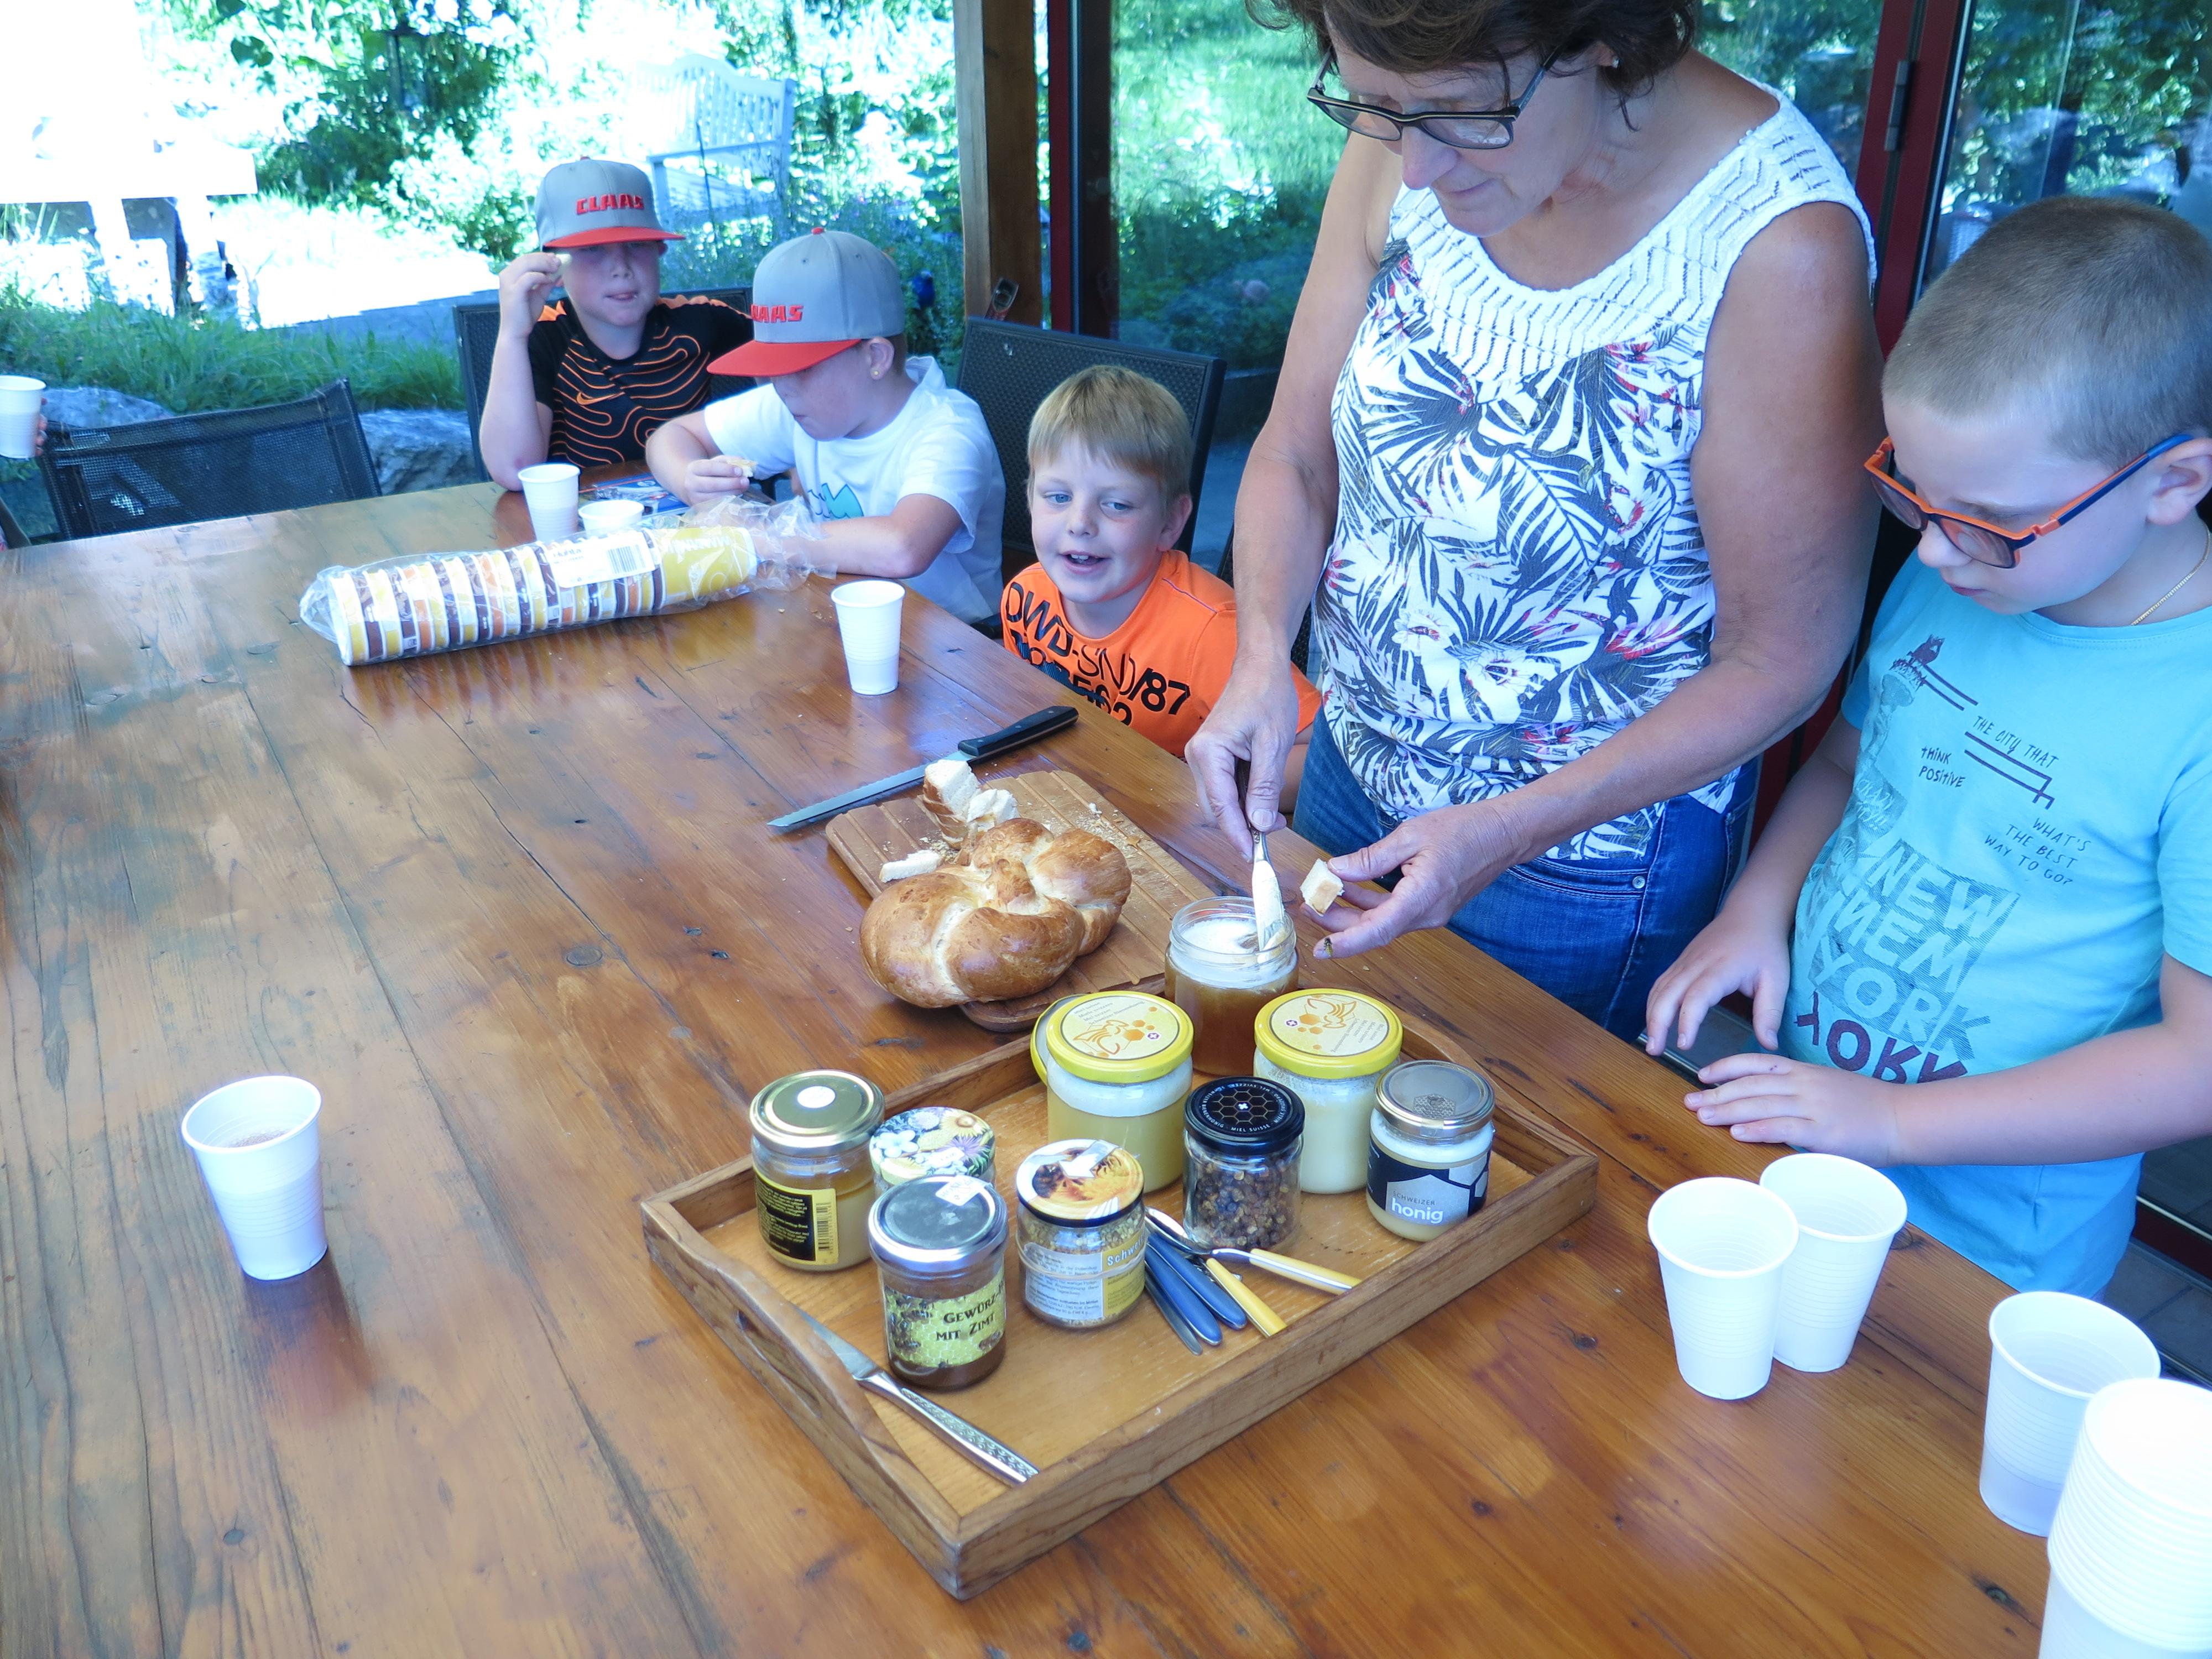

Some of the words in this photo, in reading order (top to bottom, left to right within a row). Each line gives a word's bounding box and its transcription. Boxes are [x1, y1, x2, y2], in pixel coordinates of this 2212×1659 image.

[576, 194, 644, 215] CLAAS
[1973, 716, 1995, 735] THE
[2023, 744, 2059, 769] THAT
[2006, 824, 2034, 847] THE
[2036, 845, 2078, 868] BEST
[2032, 817, 2091, 852] WHAT'S
[1984, 834, 2012, 857] WAY
[2018, 854, 2039, 871] TO
[1865, 846, 2019, 938] NEW
[1814, 936, 1991, 1061] YORK
[1249, 1123, 1271, 1132] SUISSE
[1391, 1197, 1444, 1224] honig
[1392, 1191, 1436, 1206] SCHWEIZER
[936, 1329, 961, 1341] MIT
[969, 1312, 995, 1335] ZIMT
